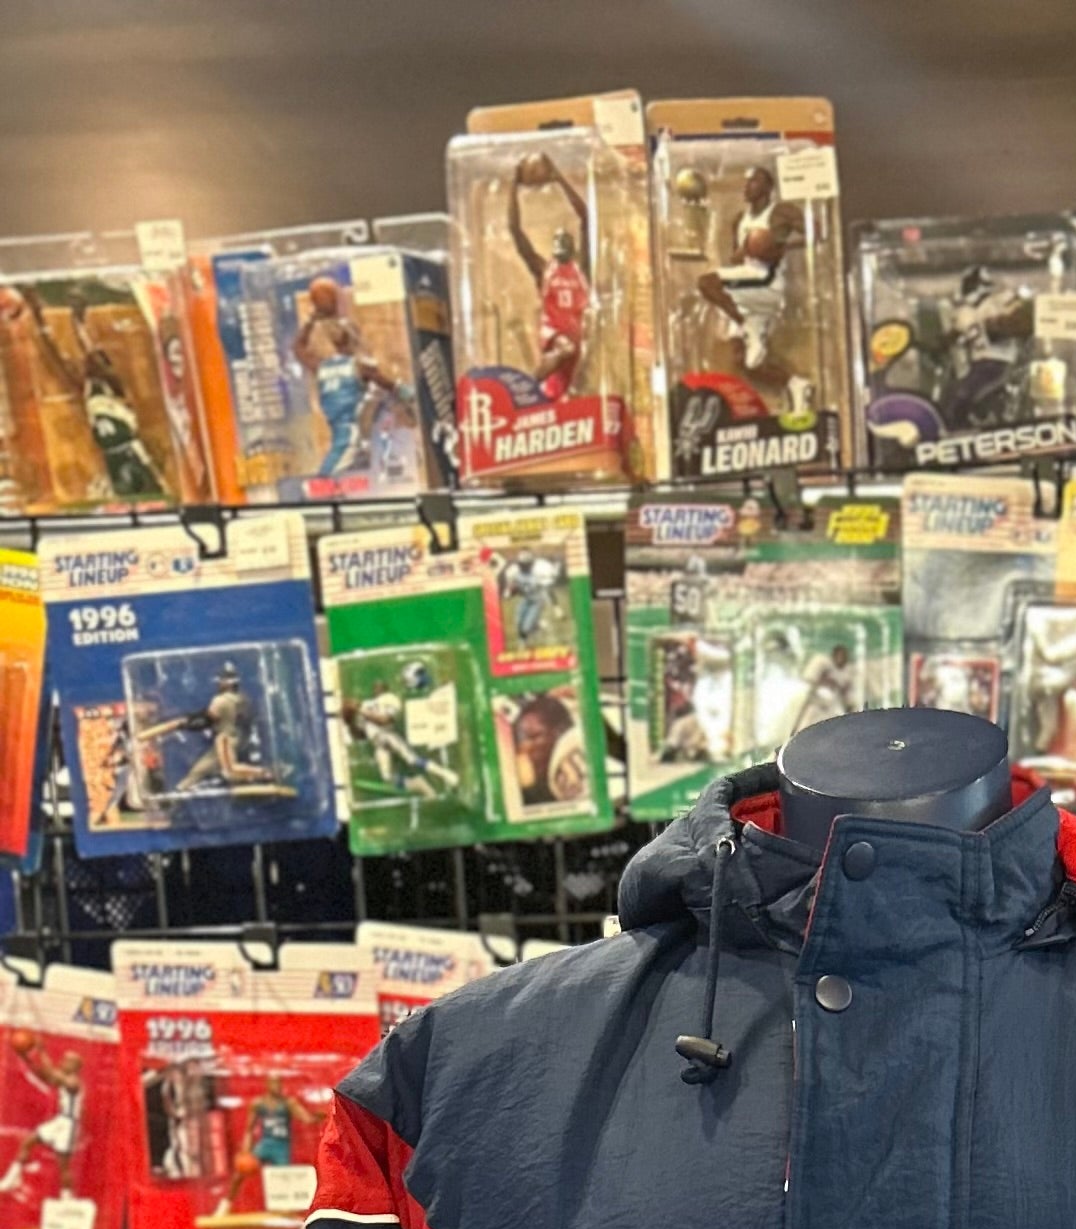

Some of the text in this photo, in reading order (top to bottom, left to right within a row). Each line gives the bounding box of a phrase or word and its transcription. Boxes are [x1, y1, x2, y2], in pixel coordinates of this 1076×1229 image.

[513, 409, 556, 431] JAMES
[495, 419, 593, 463] HARDEN
[702, 432, 817, 473] LEONARD
[907, 493, 1008, 516] STARTING
[642, 507, 732, 527] STARTING
[655, 523, 718, 543] LINEUP
[54, 549, 139, 572] STARTING
[329, 544, 424, 572] STARTING
[69, 567, 129, 588] LINEUP
[344, 567, 412, 589] LINEUP
[69, 603, 137, 631] 1996
[72, 627, 140, 646] EDITION
[131, 963, 216, 983] STARTING
[144, 977, 206, 997] LINEUP
[146, 1016, 212, 1041] 1996
